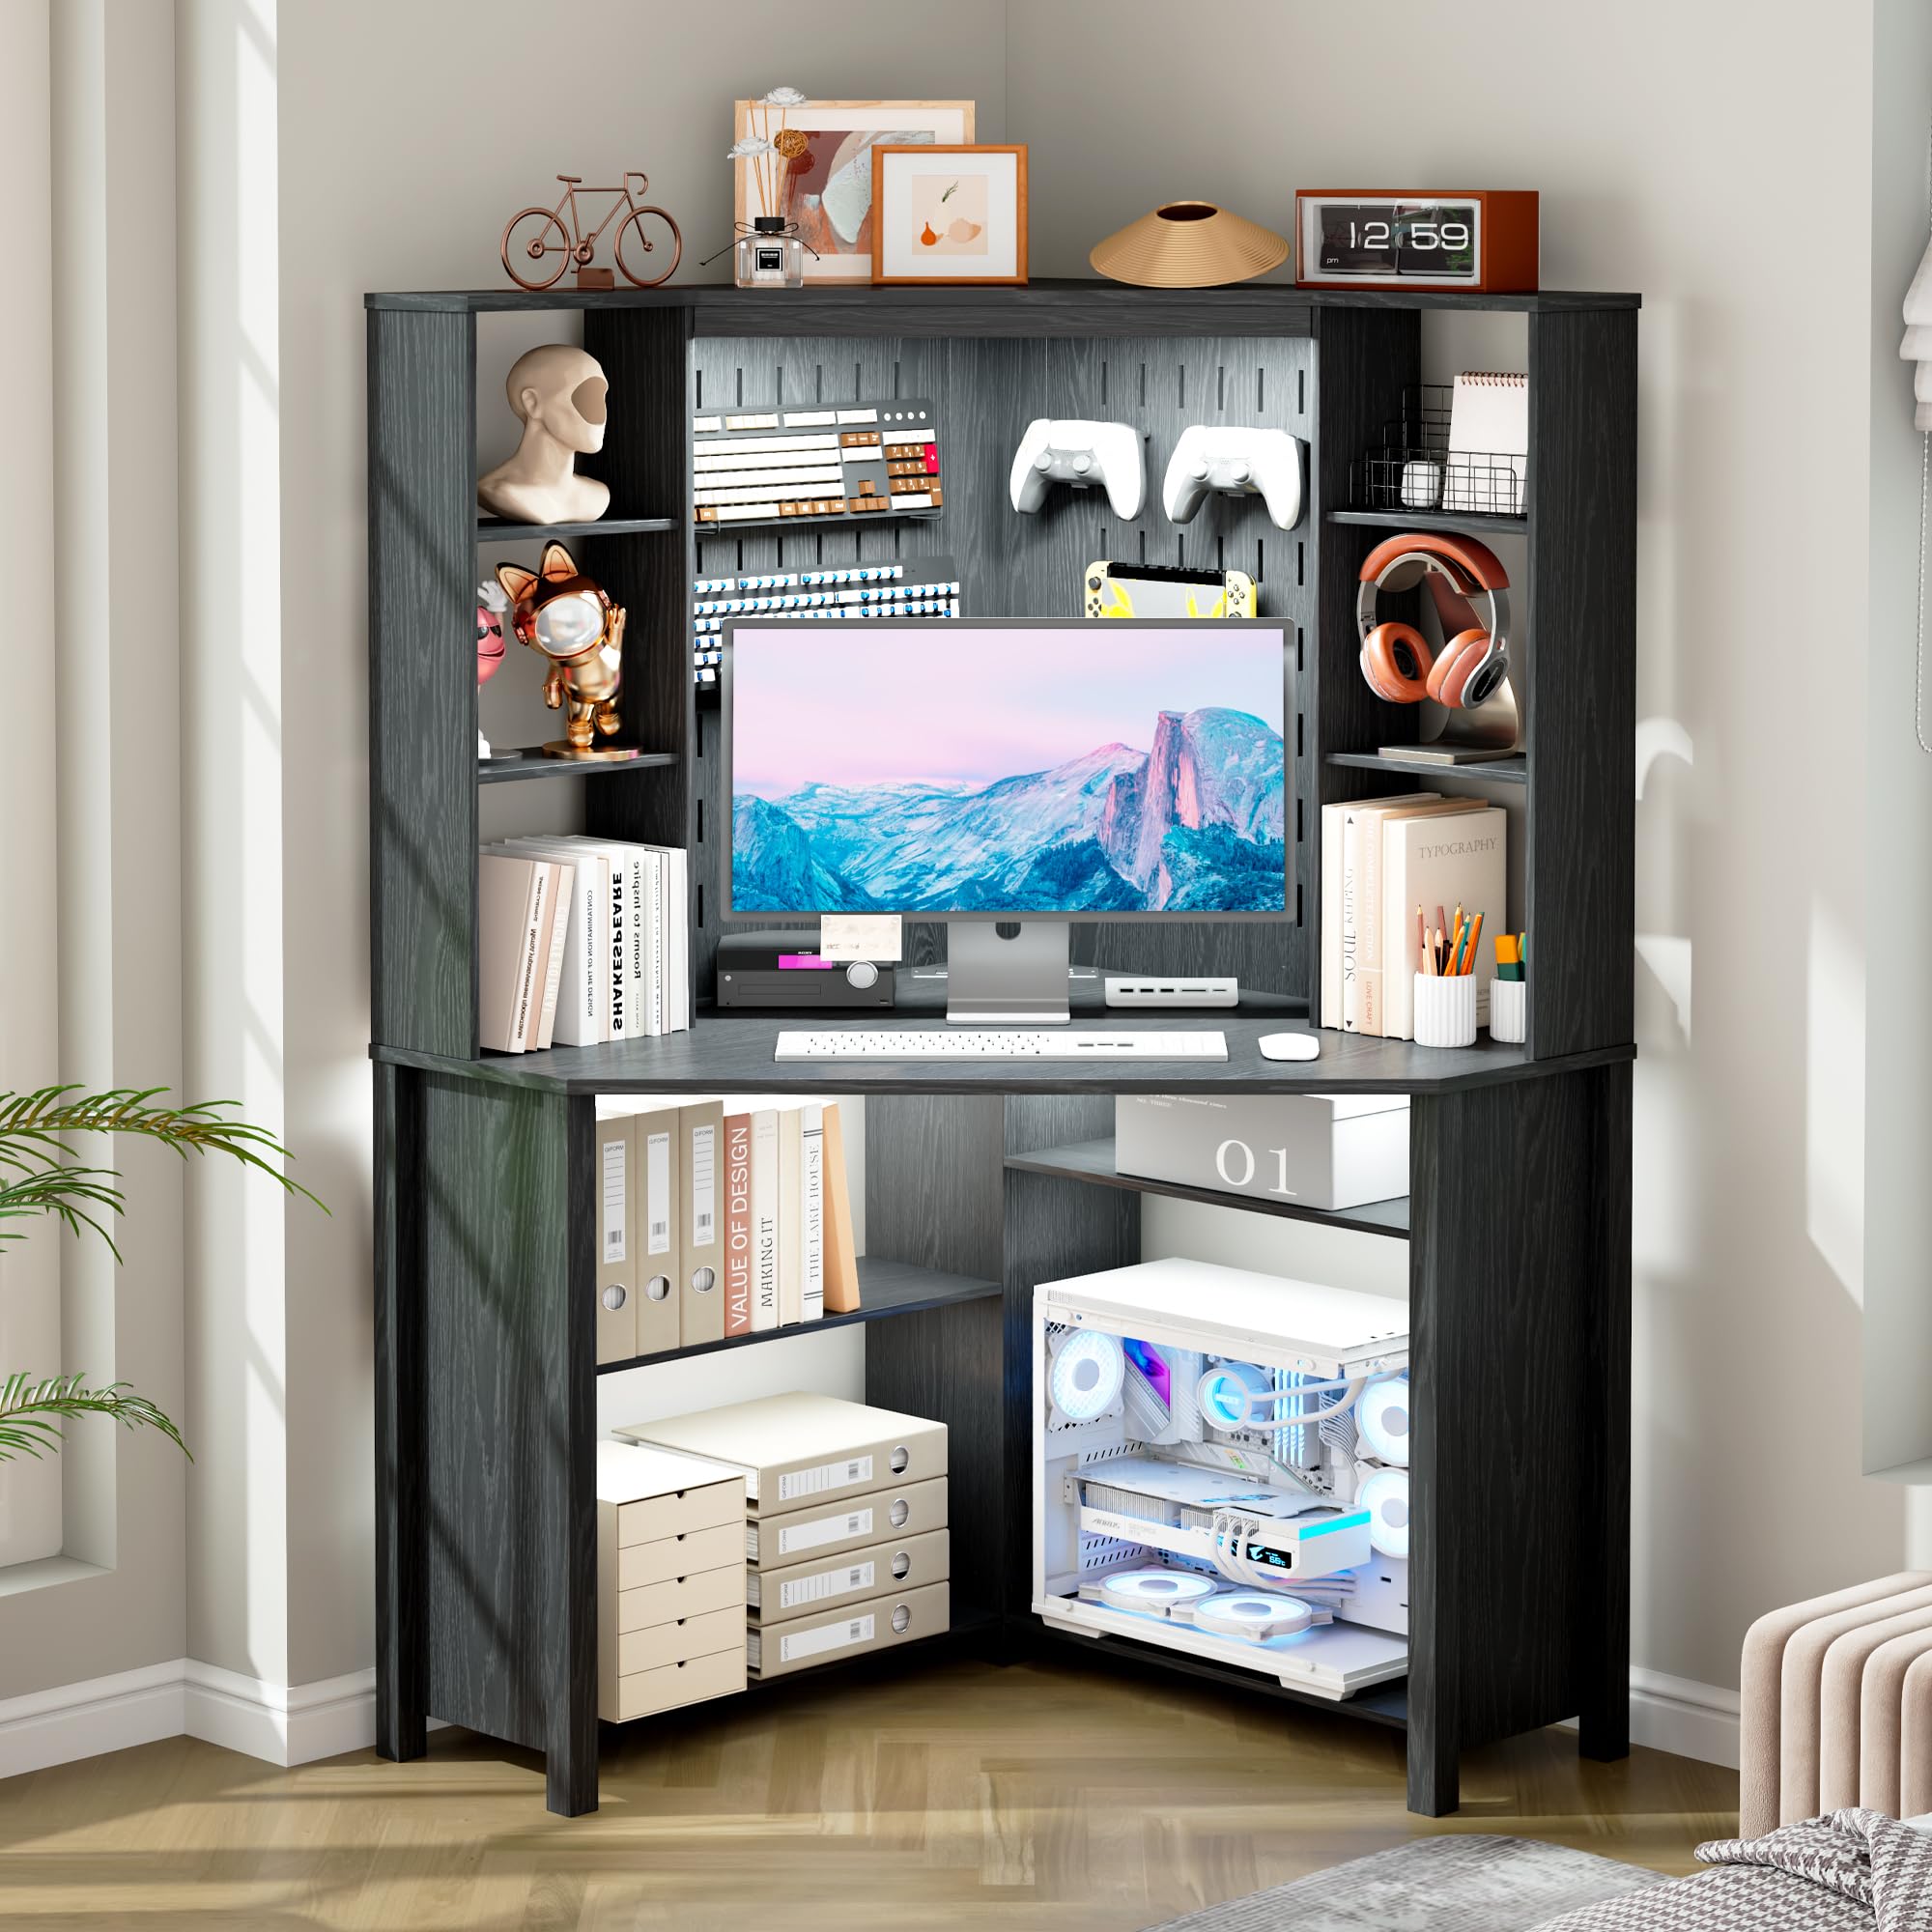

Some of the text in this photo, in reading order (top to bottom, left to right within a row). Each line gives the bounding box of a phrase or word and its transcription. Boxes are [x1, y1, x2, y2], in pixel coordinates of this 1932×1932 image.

[1350, 222, 1469, 250] 12 59
[1420, 838, 1497, 859] TYPOGRAPHY
[1344, 929, 1356, 982] SOUL
[1215, 1139, 1298, 1196] 01
[731, 1127, 748, 1328] VALUE OF DESIGN
[810, 1144, 819, 1282] THE LAKE HOUSE
[761, 1217, 773, 1307] MAKING IT
